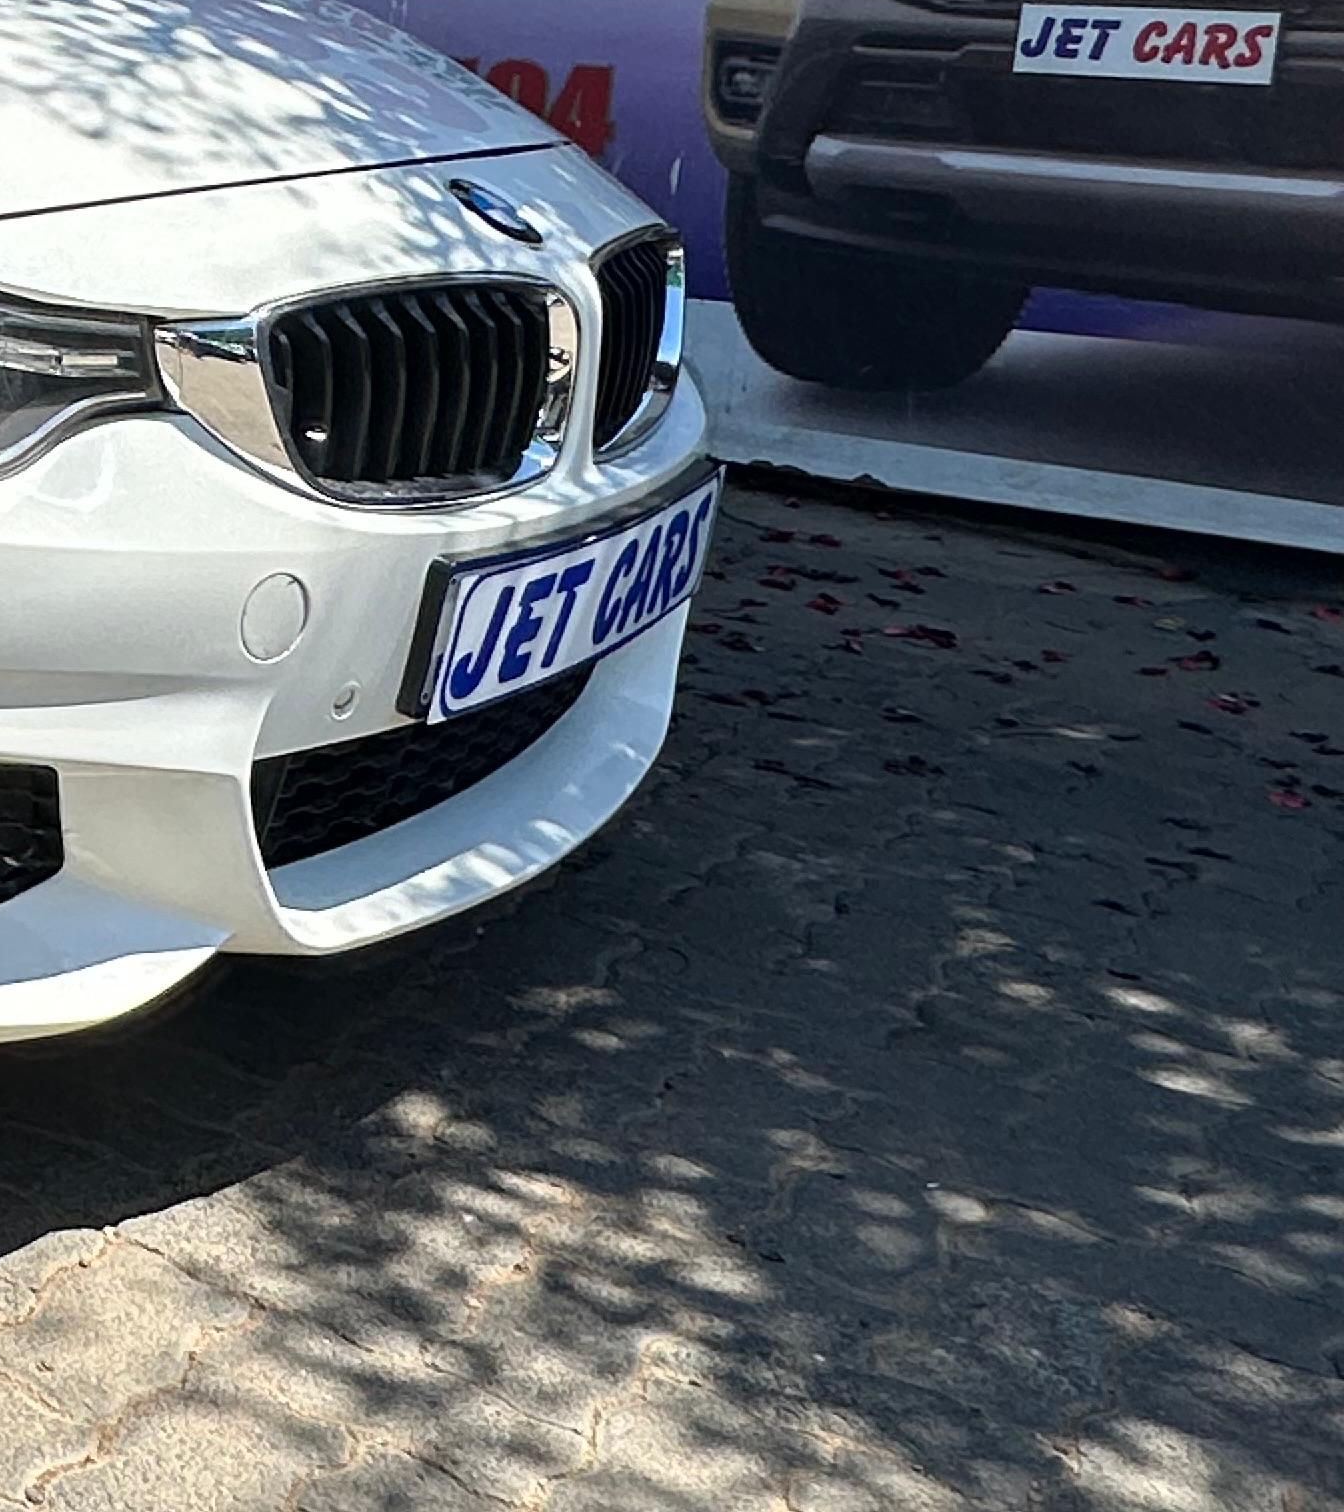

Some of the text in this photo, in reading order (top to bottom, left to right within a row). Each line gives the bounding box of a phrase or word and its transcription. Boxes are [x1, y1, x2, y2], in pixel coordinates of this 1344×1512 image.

[1019, 16, 1274, 70] JET CARS
[449, 491, 712, 700] JET CARS
